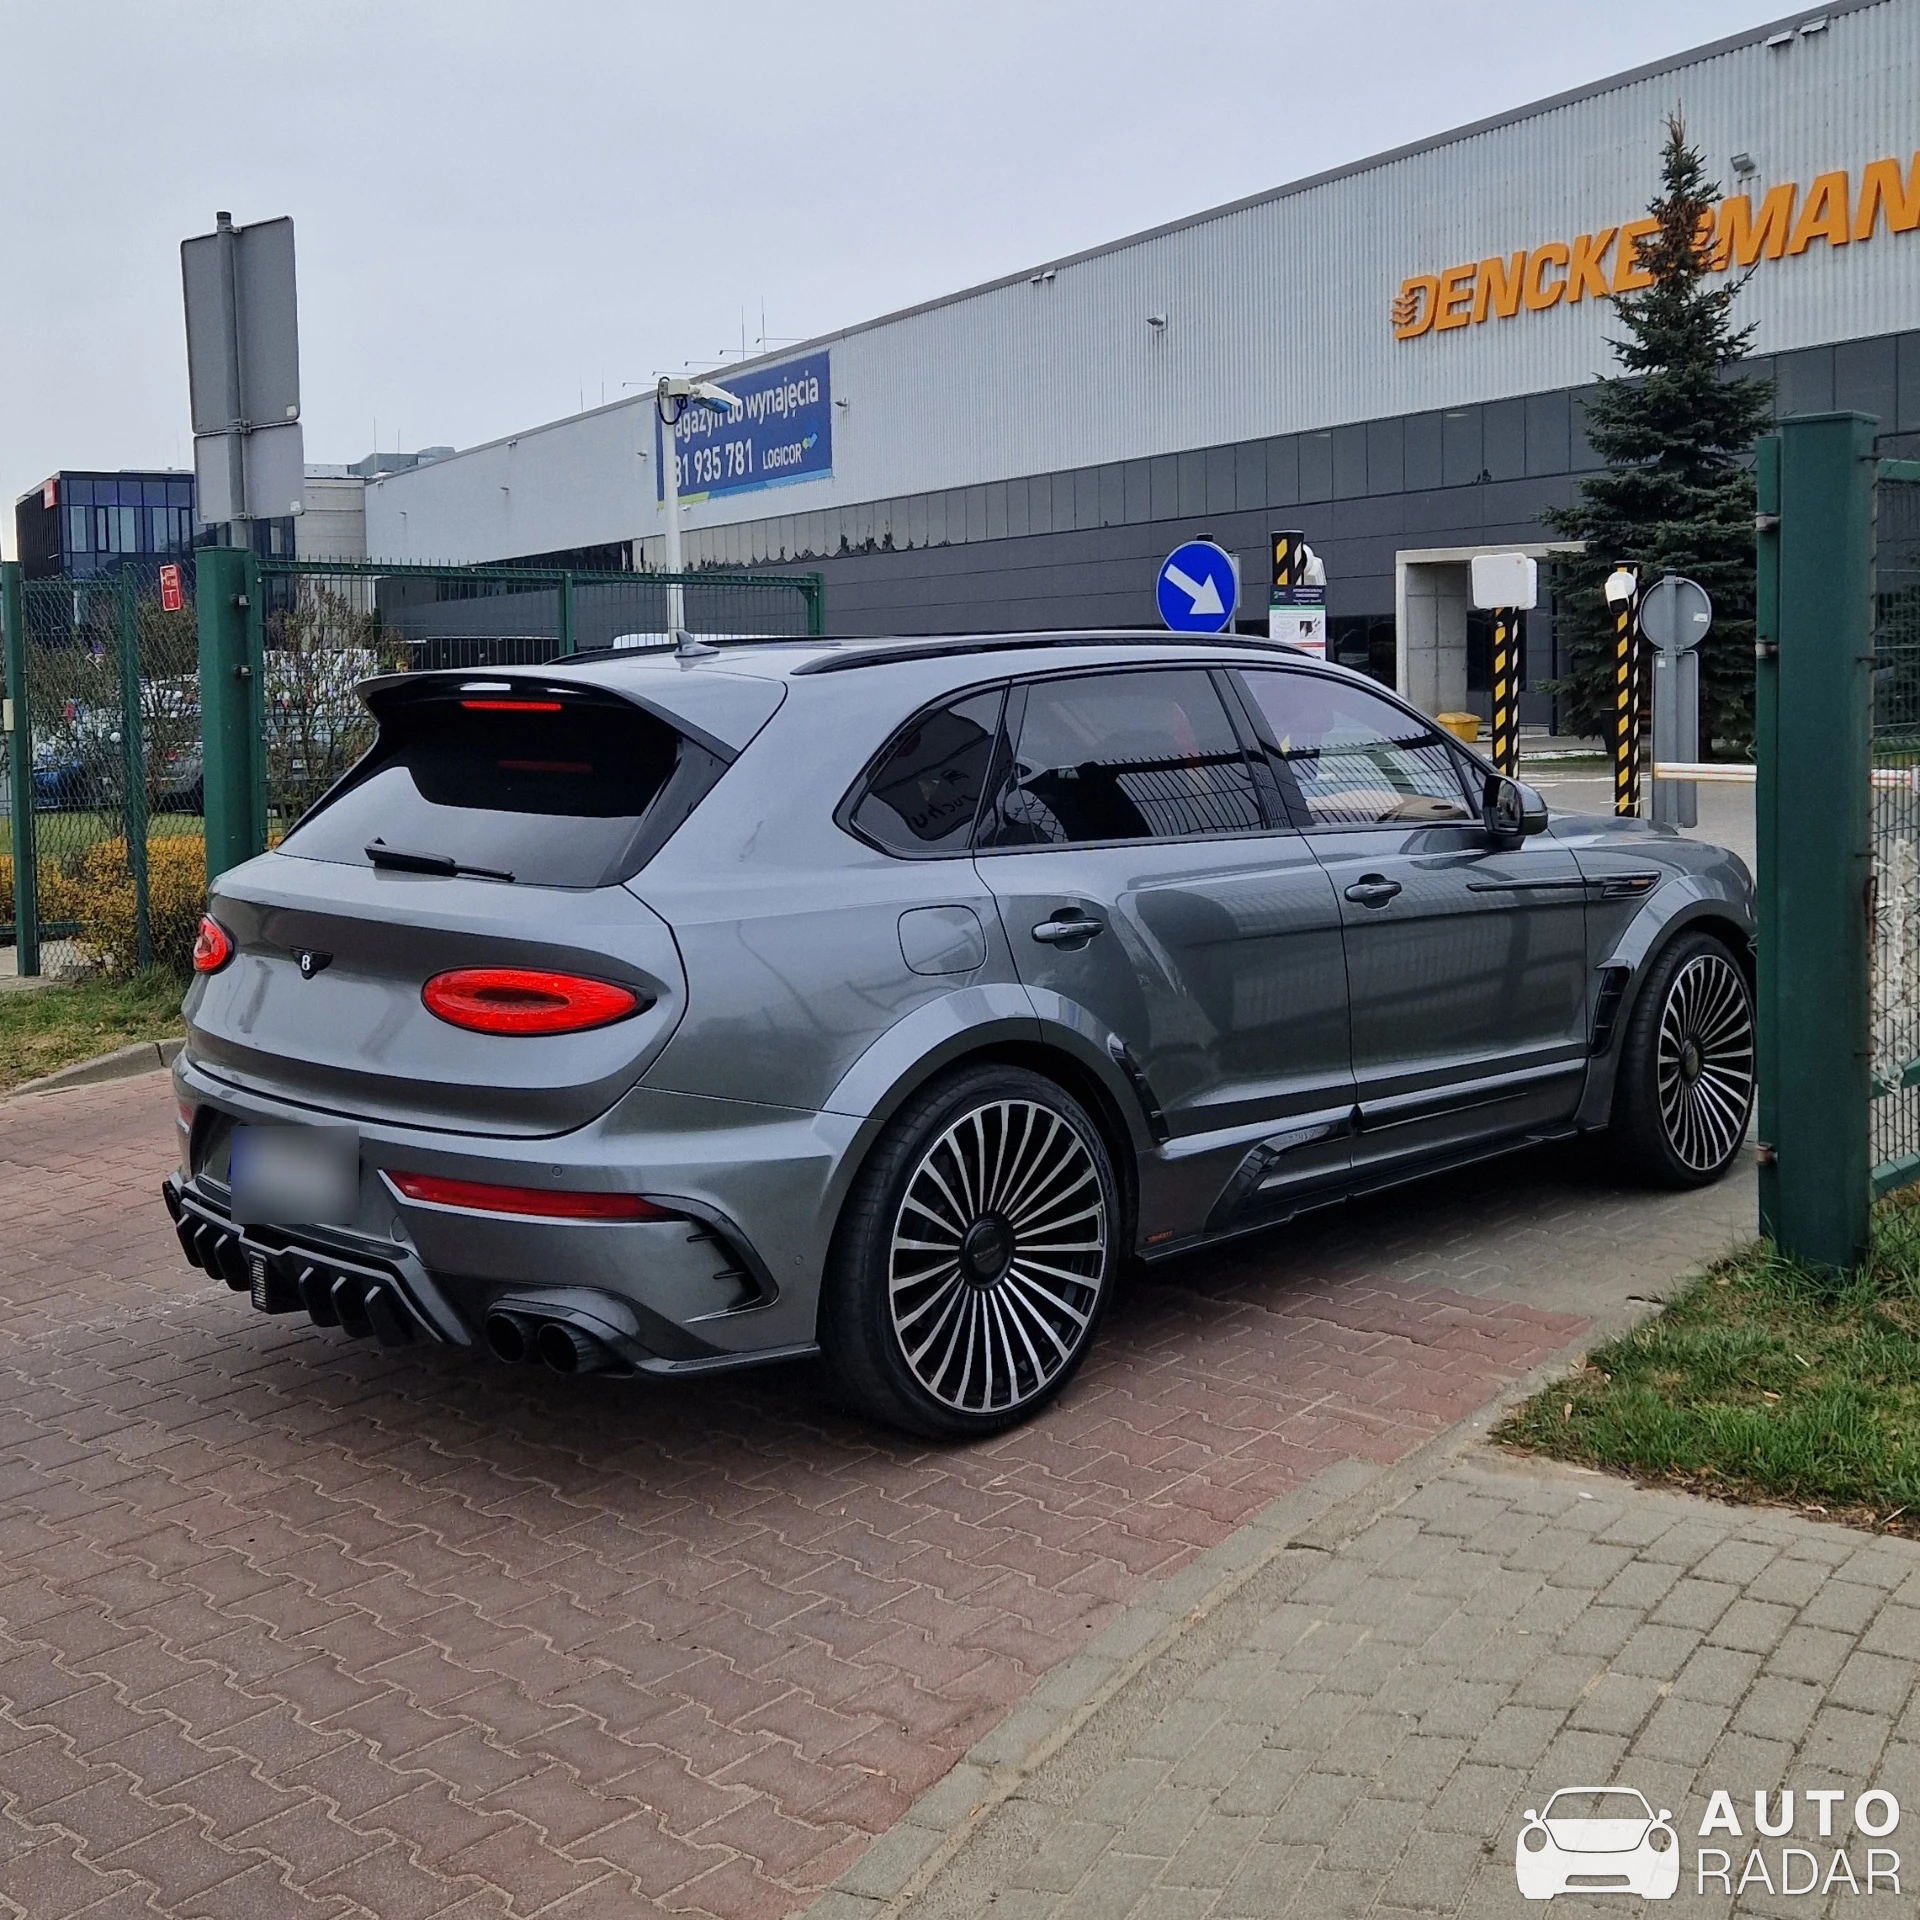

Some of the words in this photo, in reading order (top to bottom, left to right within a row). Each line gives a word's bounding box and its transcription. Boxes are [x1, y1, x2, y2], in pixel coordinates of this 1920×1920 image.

[675, 408, 723, 443] agazyn
[745, 369, 819, 425] wynajęcia
[694, 446, 722, 483] 935
[725, 438, 753, 477] 781
[762, 443, 802, 470] LOGICOR
